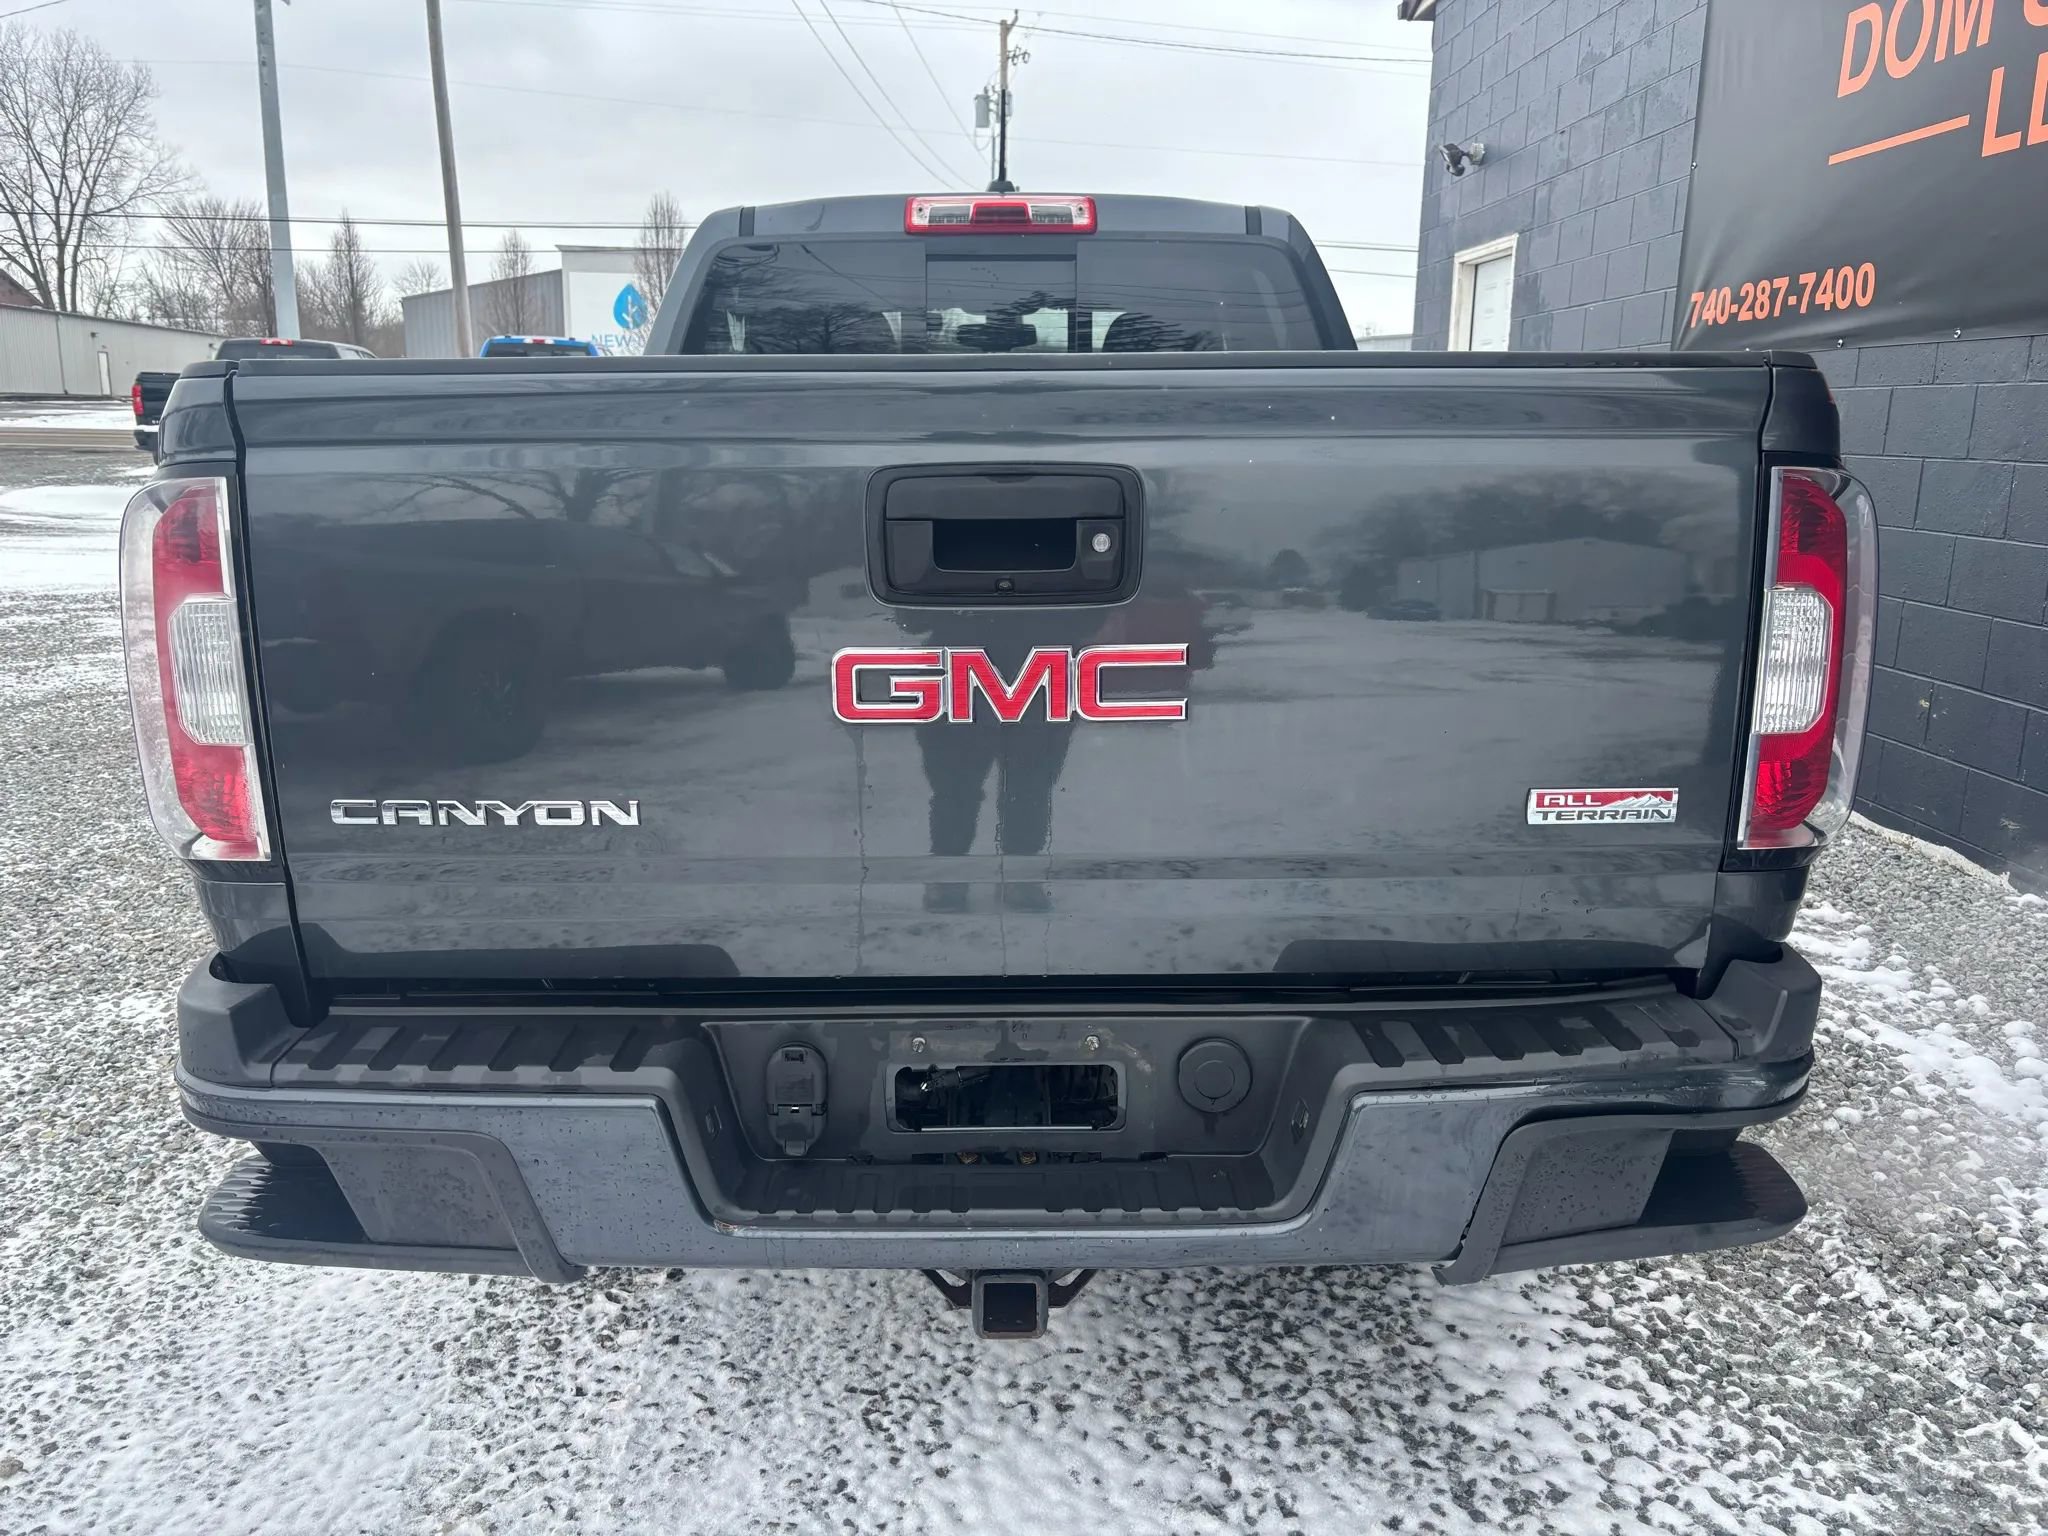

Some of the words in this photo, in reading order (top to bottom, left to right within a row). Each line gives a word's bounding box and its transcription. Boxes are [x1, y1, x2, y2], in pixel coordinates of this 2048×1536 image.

[1837, 0, 1995, 98] DOM
[1690, 262, 1876, 328] 740-287-7400
[832, 643, 1189, 723] GMC
[330, 799, 640, 826] CANYON
[1535, 809, 1672, 821] TERRAIN
[1543, 794, 1602, 807] ALL
